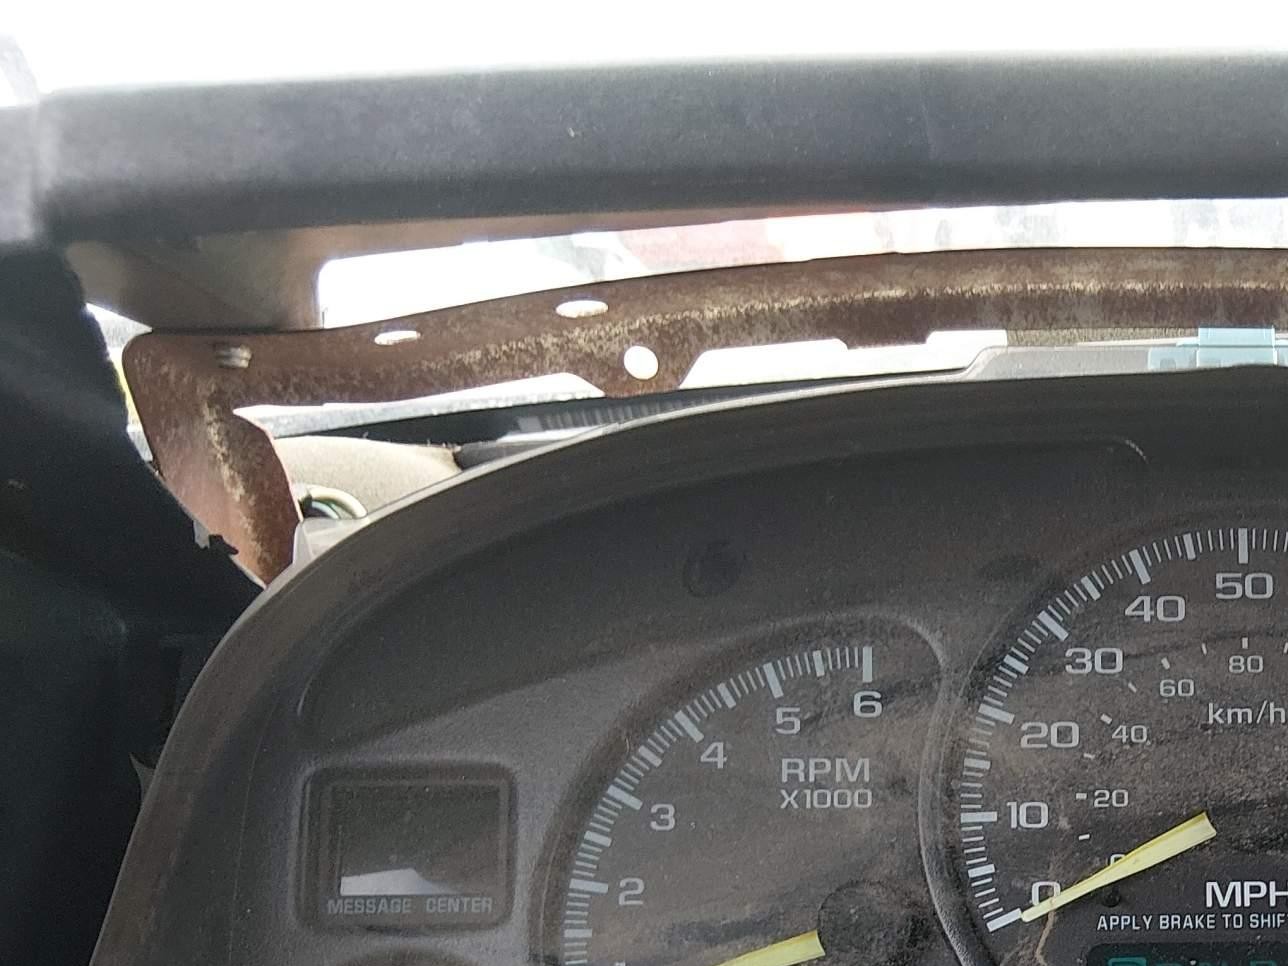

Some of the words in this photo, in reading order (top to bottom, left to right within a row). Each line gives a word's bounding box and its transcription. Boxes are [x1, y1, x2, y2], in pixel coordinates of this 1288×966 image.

[1215, 572, 1274, 600] 50
[1124, 595, 1187, 622] 40
[1064, 647, 1124, 674] 30
[1228, 653, 1264, 674] 80
[1159, 679, 1195, 698] 60
[853, 690, 883, 718] 6
[1207, 701, 1287, 725] km/h
[775, 706, 801, 735] 5
[1019, 722, 1080, 748] 20
[1111, 724, 1148, 744] 40
[701, 741, 728, 769] 4
[781, 758, 871, 783] RPM
[780, 789, 873, 809] X1000
[1093, 789, 1129, 808] 20
[649, 803, 676, 831] 3
[1006, 801, 1049, 829] 10
[618, 877, 644, 906] 2
[1032, 880, 1061, 907] 0
[327, 897, 412, 914] MESSAGE
[426, 897, 492, 913] CENTER
[1097, 915, 1153, 930] APPLY
[1159, 914, 1216, 930] BRAKE
[1222, 913, 1243, 929] TO
